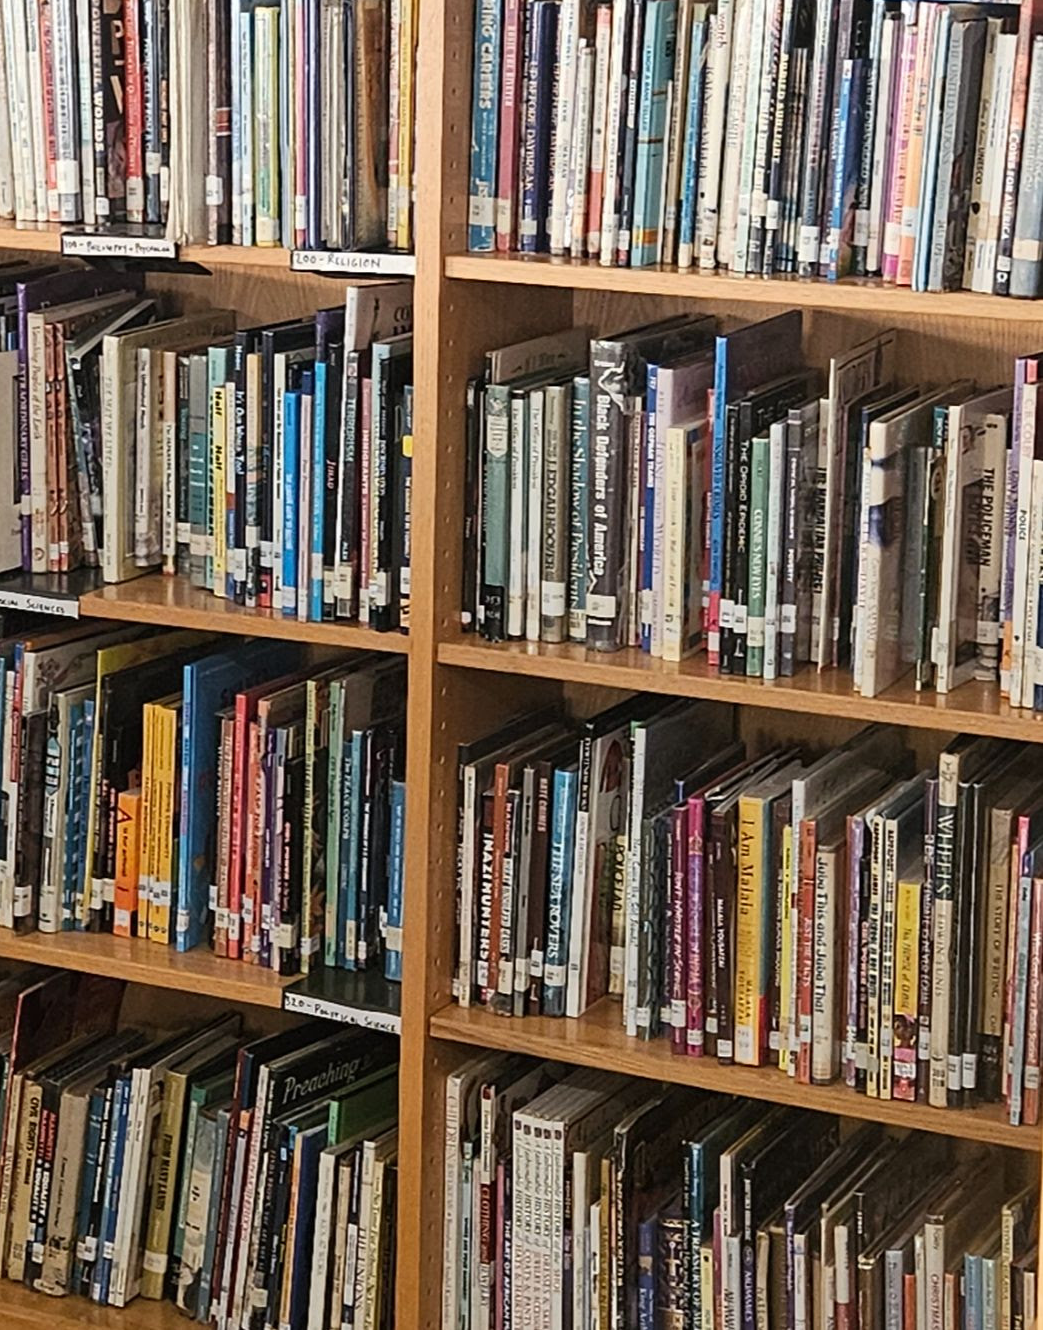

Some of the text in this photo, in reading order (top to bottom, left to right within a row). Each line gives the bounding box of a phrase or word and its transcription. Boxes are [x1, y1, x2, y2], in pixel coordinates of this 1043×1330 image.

[479, 42, 493, 109] CAREERS
[526, 79, 537, 125] BEFORE
[777, 54, 789, 99] BURIED
[94, 91, 104, 151] WORDS
[524, 129, 536, 191] DAYBREAK
[975, 147, 985, 184] UNESCO
[1001, 133, 1019, 239] COWS FOR AMERICA
[295, 253, 317, 265] 200
[327, 253, 381, 268] RELIGION
[345, 399, 356, 461] TERRORISM
[647, 413, 655, 426] THE
[647, 429, 655, 458] ORPHAN
[20, 450, 28, 479] GIRLS
[360, 430, 369, 494] IMMIGRANTS
[740, 440, 749, 461] THE
[546, 469, 557, 513] EDGAR
[568, 399, 586, 610] In the Shadow of Presidents
[594, 394, 609, 575] Black Defenders of America
[545, 517, 556, 570] HOOVER
[980, 468, 994, 566] THE POLICEMAN
[118, 809, 132, 823] A
[343, 776, 351, 805] PEACE
[342, 808, 350, 839] CORPS
[741, 831, 753, 857] Am
[935, 814, 953, 897] WHEELS
[480, 840, 494, 958] NAZI HUNTERS
[547, 842, 563, 958] THE SEA ROVERS
[741, 862, 753, 915] Malala
[815, 857, 828, 1013] Juba This and Juba That
[990, 884, 1003, 997] THE STORY OF WRITING
[26, 1097, 40, 1151] CIVIL RIGHTS
[161, 1134, 173, 1157] FROM
